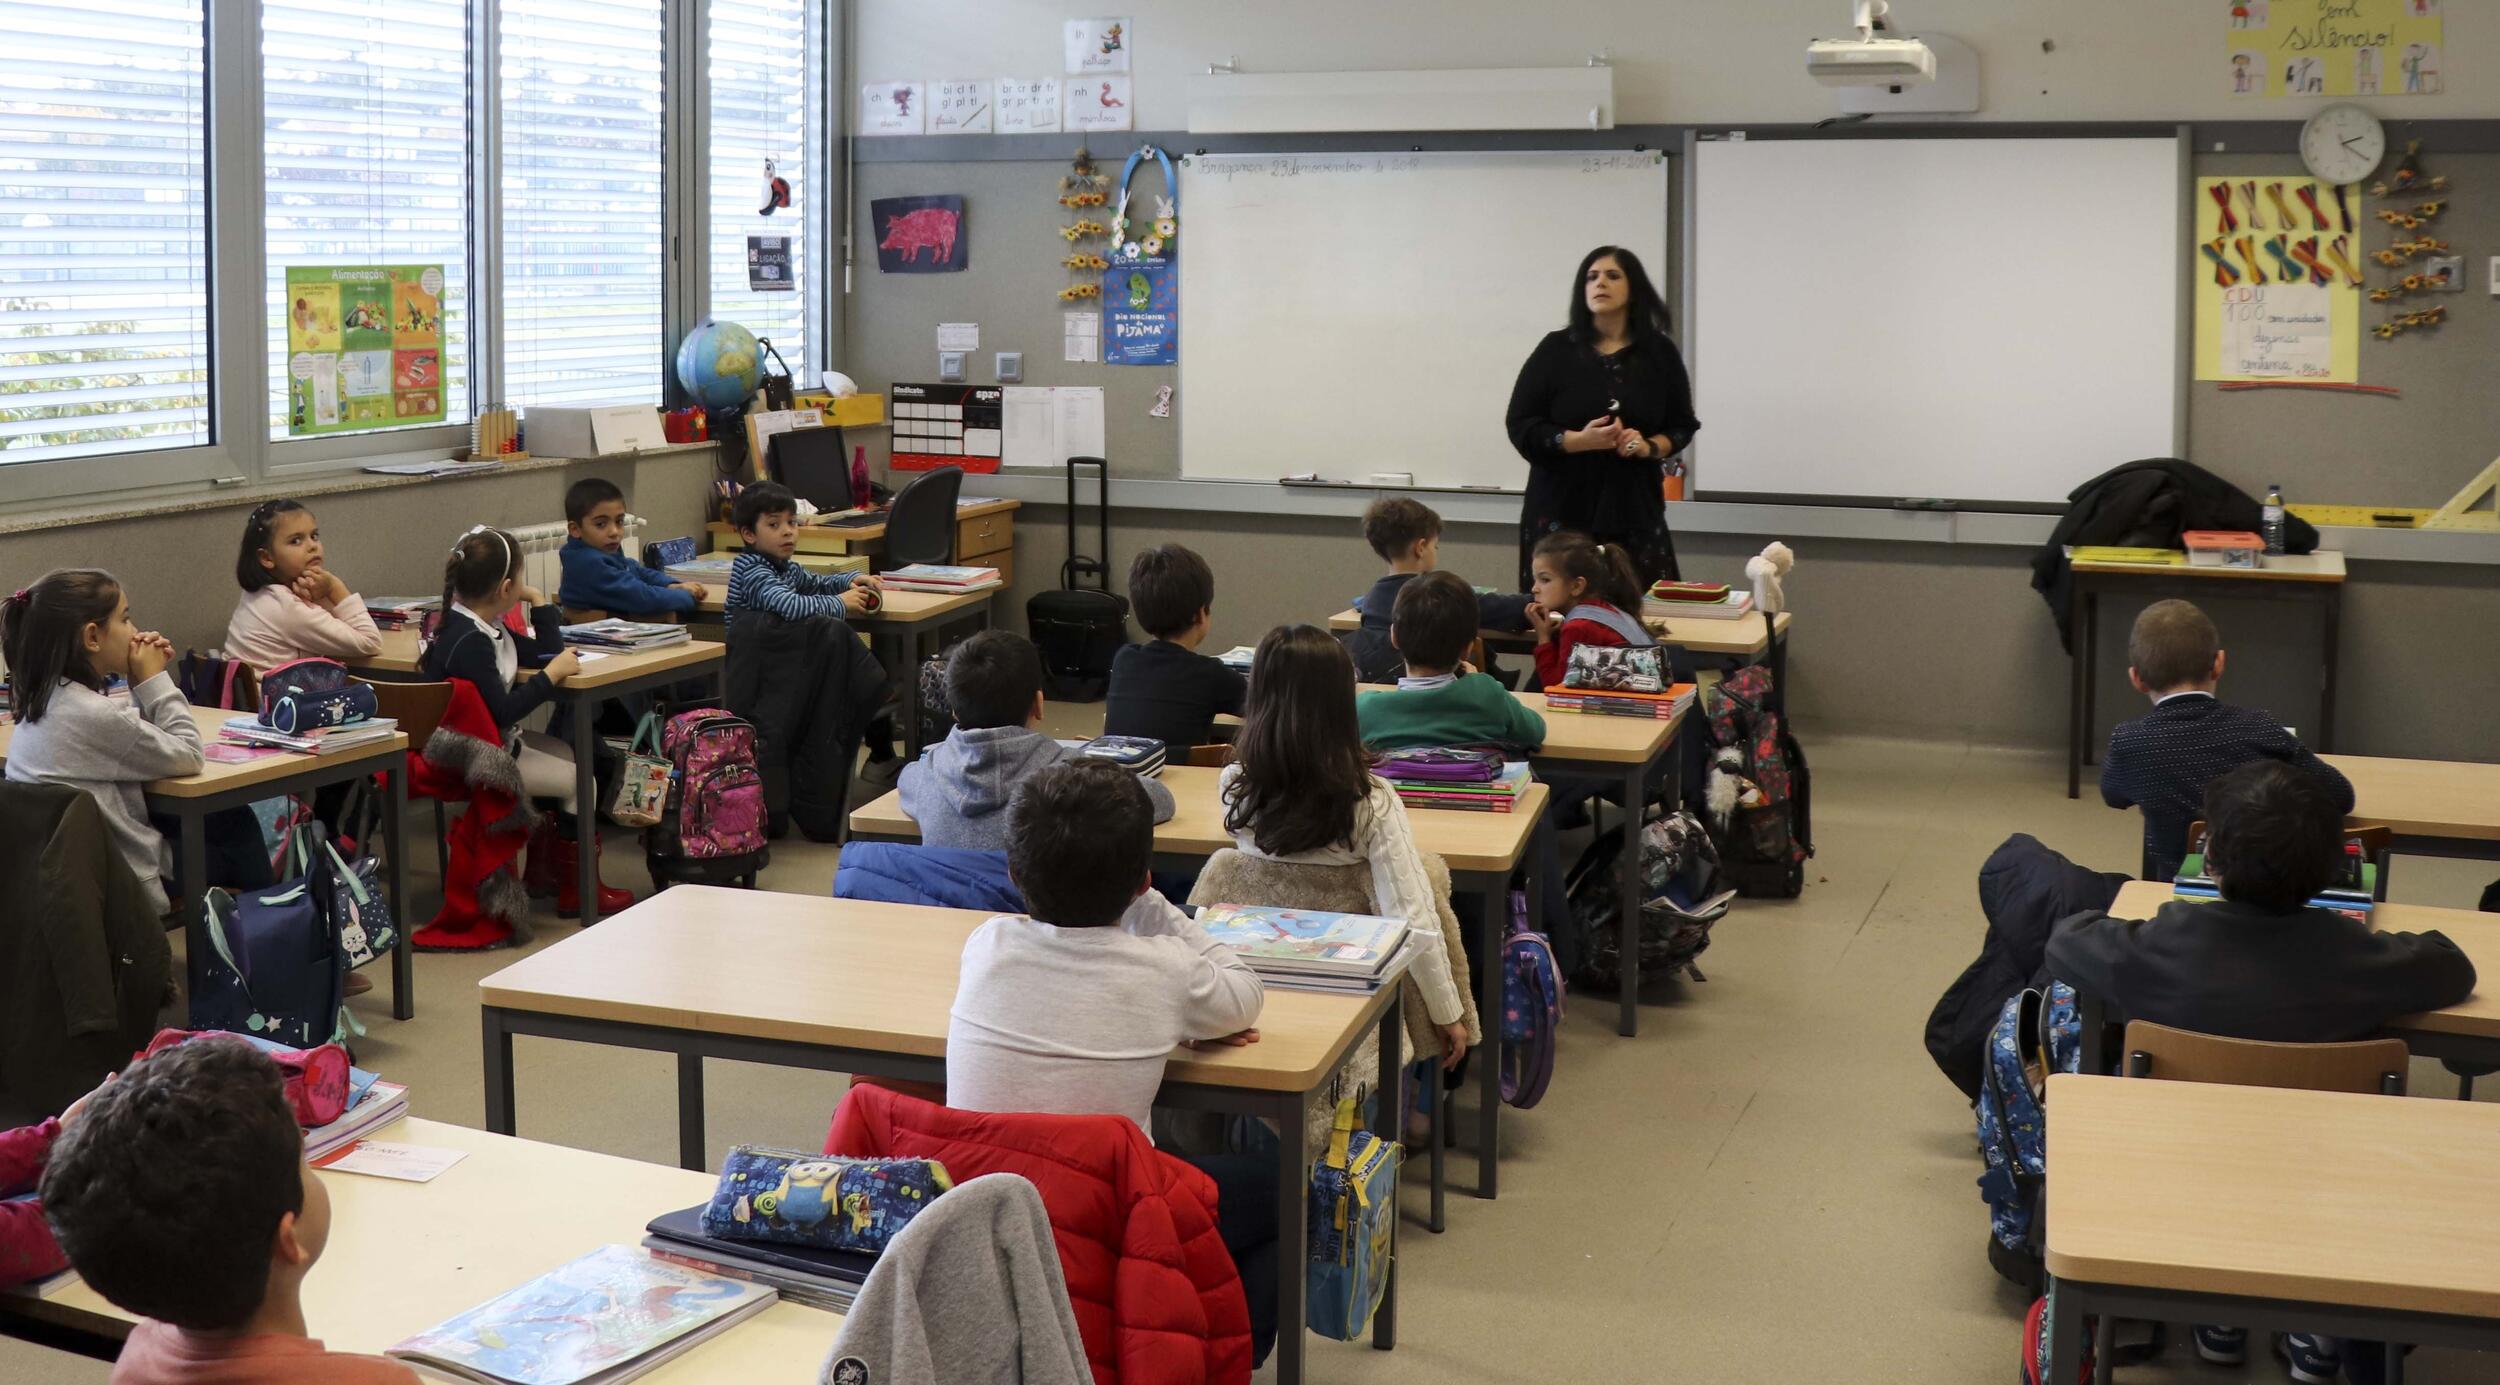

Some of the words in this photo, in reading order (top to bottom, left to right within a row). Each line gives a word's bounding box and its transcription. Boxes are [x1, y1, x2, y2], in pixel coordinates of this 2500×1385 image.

[1002, 84, 1013, 94] br
[1074, 85, 1088, 97] nh
[871, 92, 882, 103] ch
[1113, 254, 1127, 265] 20
